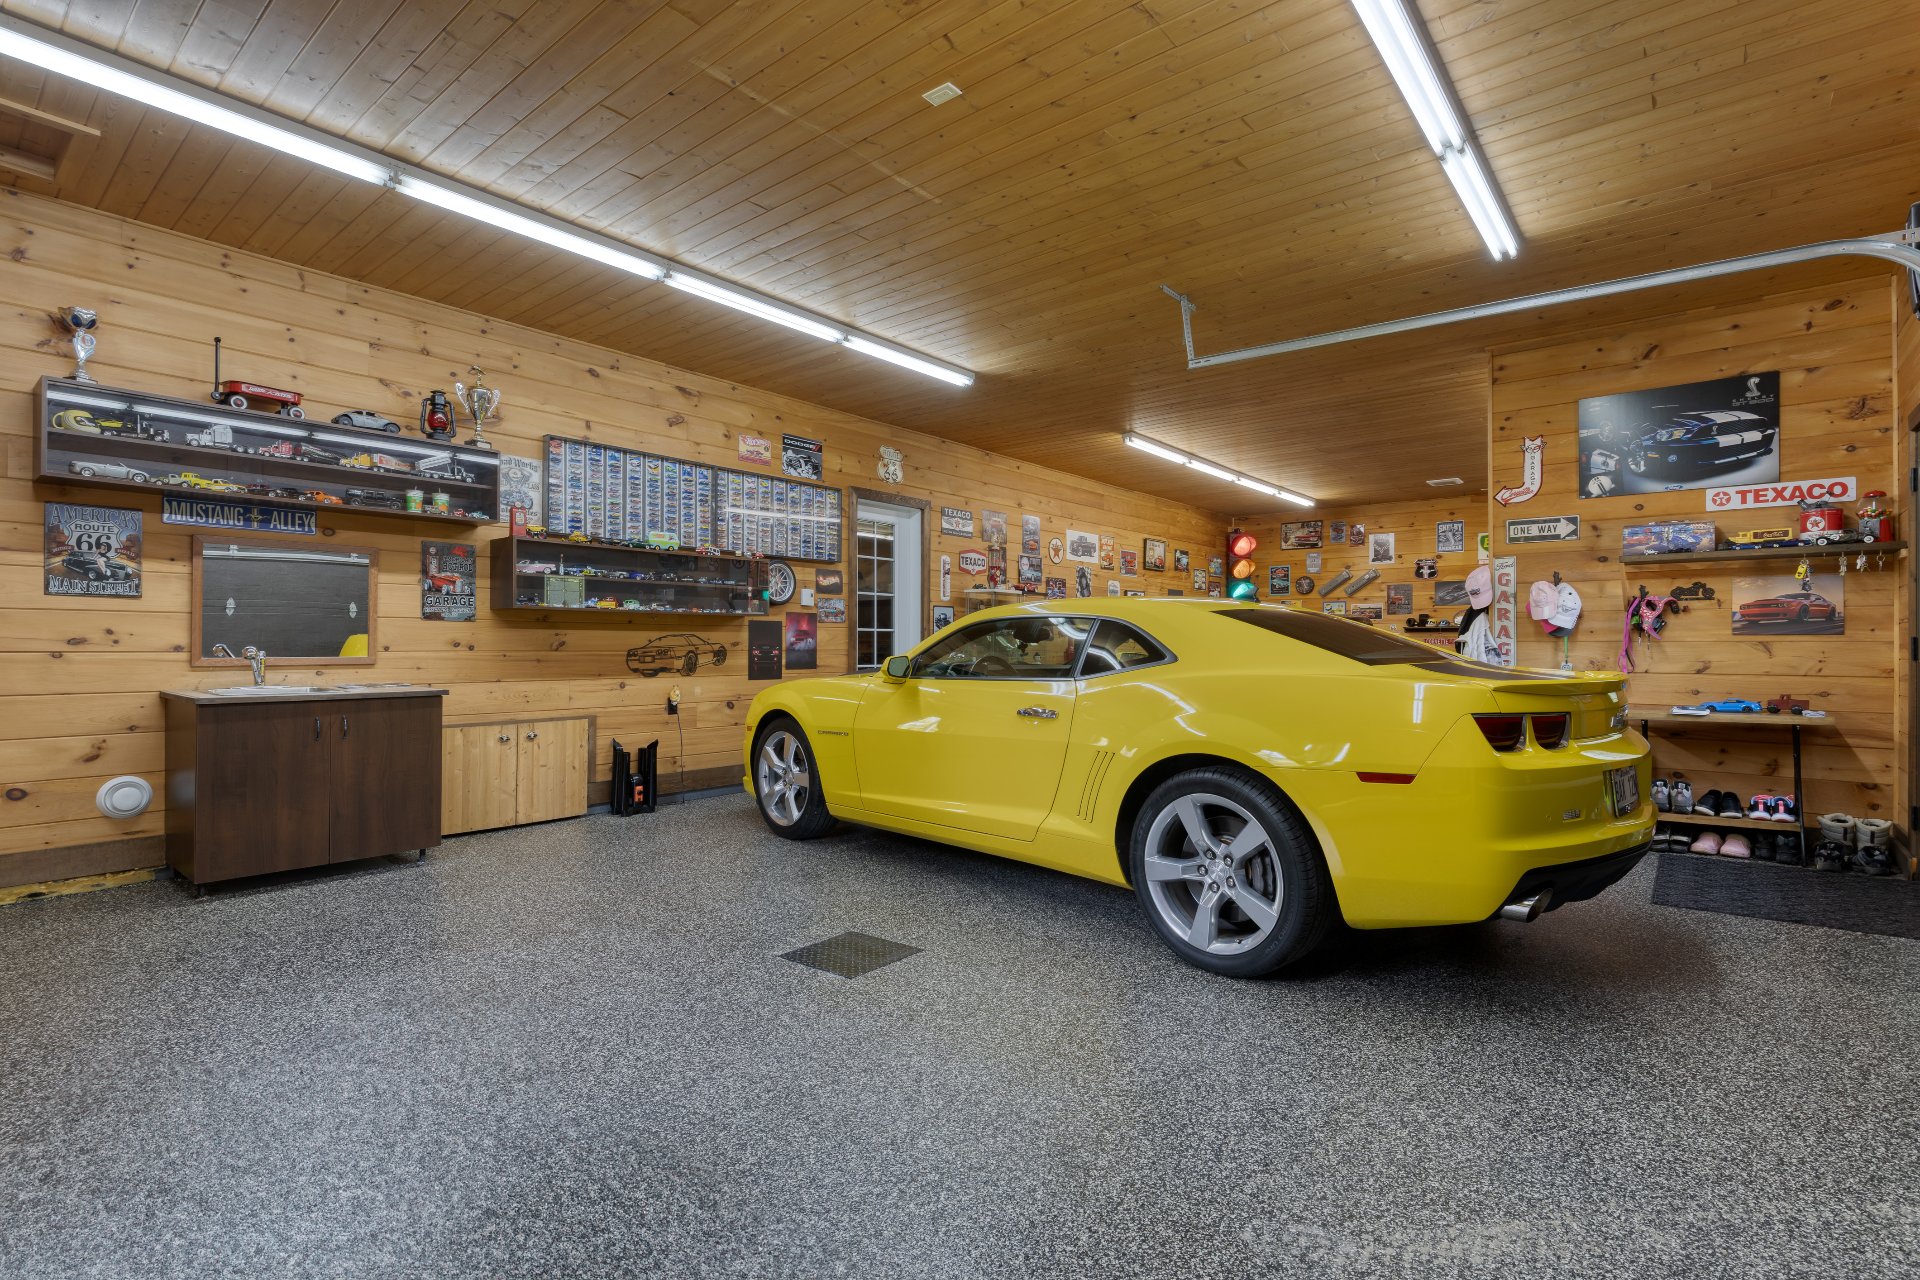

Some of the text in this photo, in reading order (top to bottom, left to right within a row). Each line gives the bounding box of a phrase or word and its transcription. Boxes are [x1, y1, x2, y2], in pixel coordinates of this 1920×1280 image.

[784, 438, 814, 449] DODGE
[1735, 481, 1848, 504] TEXACO
[171, 501, 311, 532] MUSTANG ALLEY
[944, 508, 971, 519] TEXACO
[74, 523, 115, 533] ROUTE
[1513, 524, 1558, 536] ONE WAY
[75, 533, 112, 555] 66
[960, 556, 986, 568] TEXACO
[48, 575, 139, 593] MAIN STREET
[425, 594, 475, 607] GARAGE
